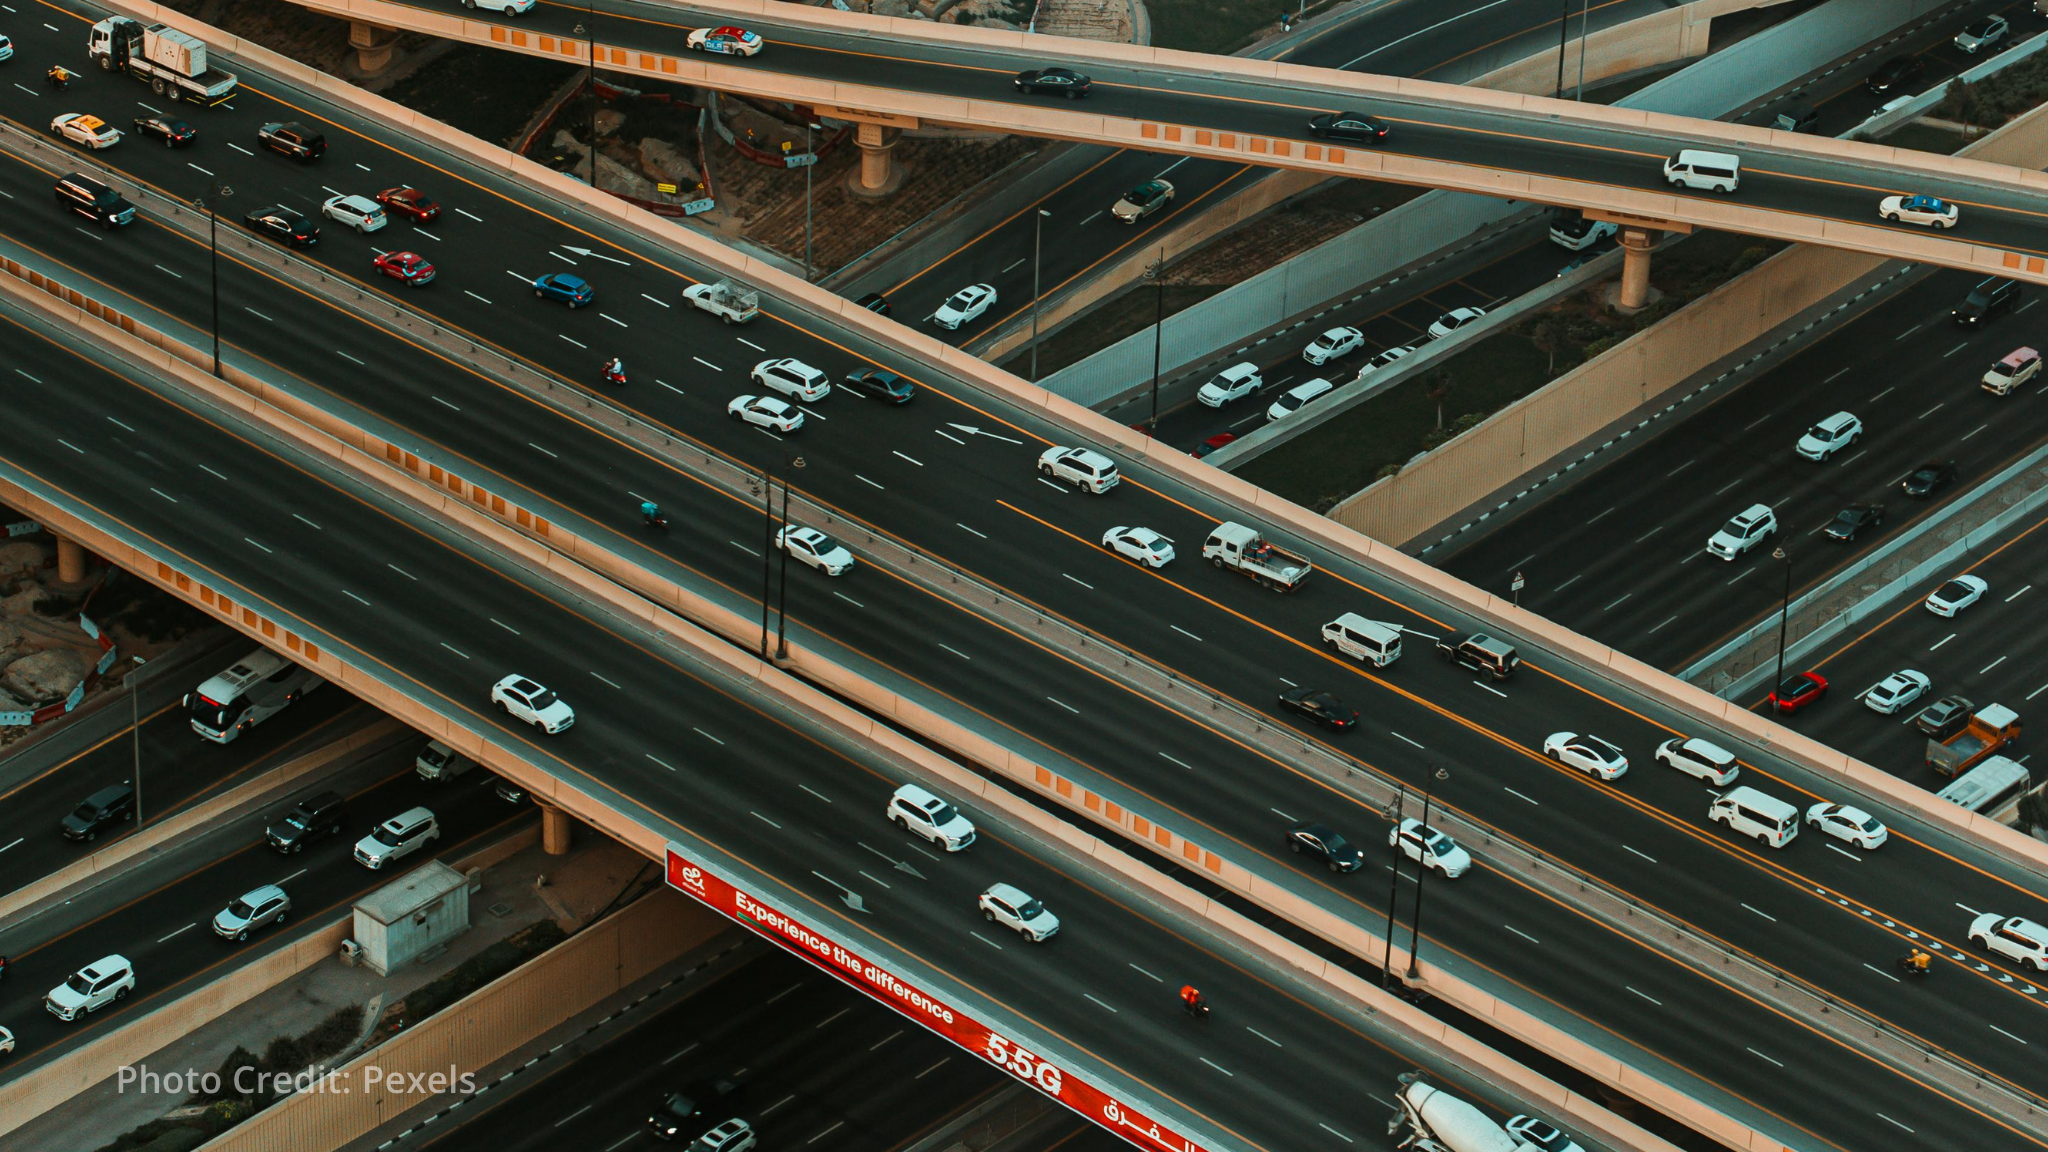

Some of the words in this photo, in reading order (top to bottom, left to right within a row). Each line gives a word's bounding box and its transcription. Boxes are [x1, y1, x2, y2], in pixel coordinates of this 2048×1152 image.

[735, 891, 831, 956] Experience
[833, 946, 862, 973] the
[864, 966, 954, 1024] difference
[985, 1032, 1062, 1096] 5.5G
